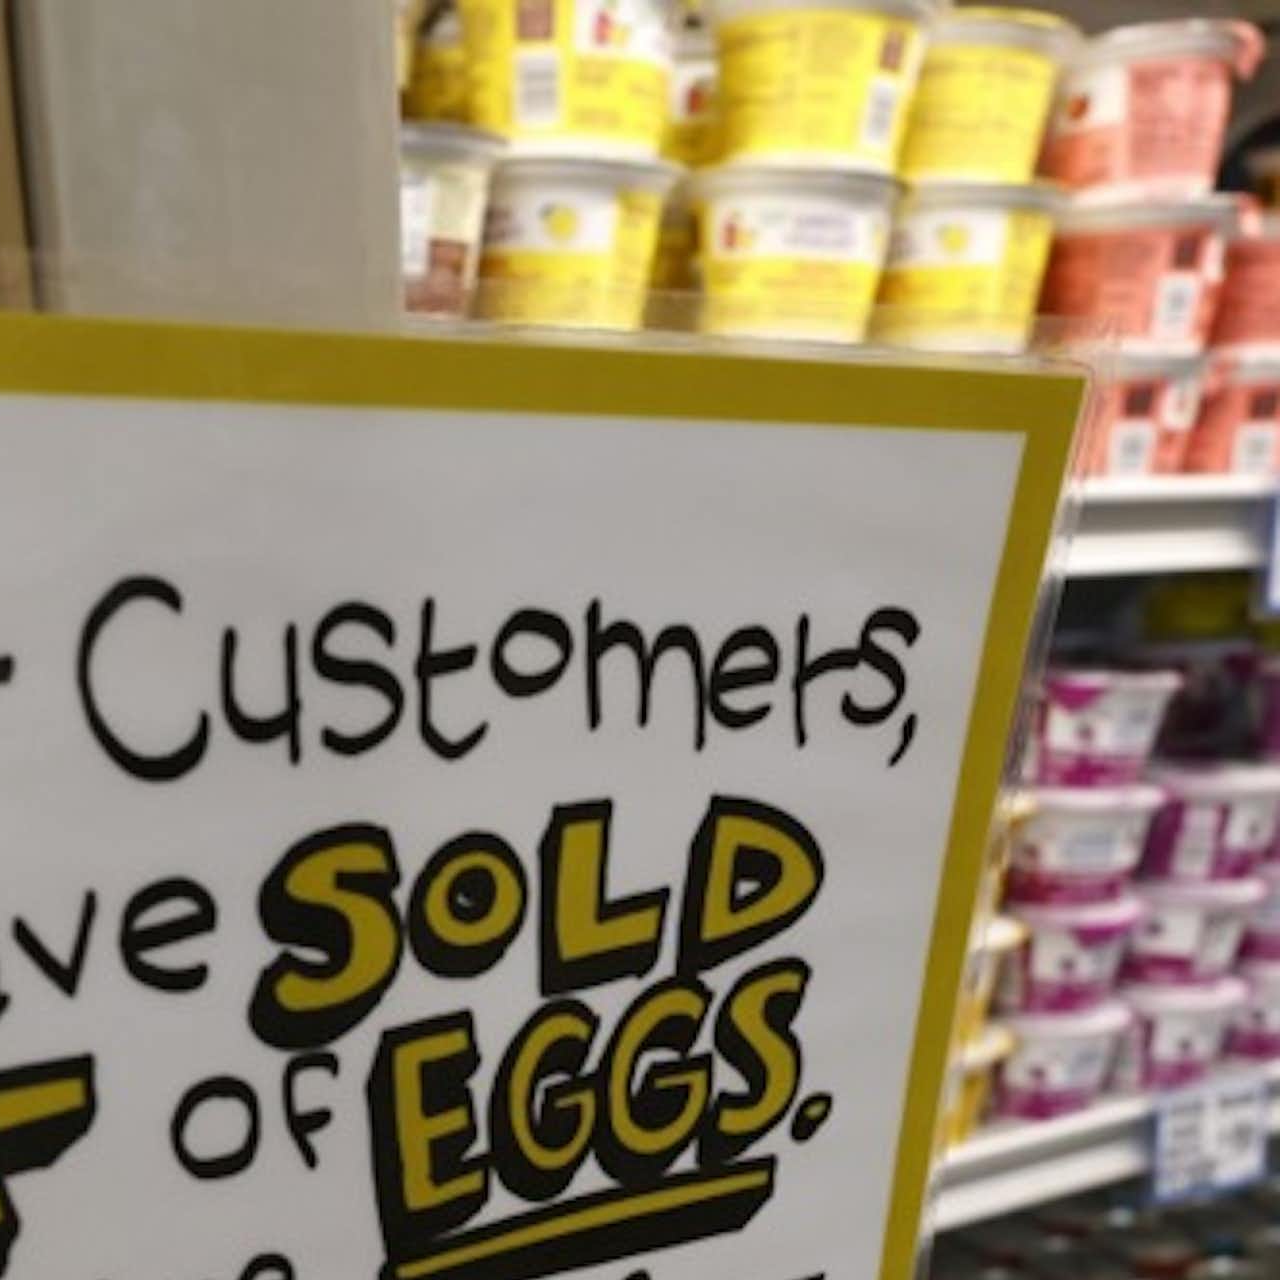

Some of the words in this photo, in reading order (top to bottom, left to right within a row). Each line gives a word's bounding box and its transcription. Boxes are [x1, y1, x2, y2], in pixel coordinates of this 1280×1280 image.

[75, 574, 922, 784] Customers,
[246, 793, 827, 1051] SOLD
[363, 955, 834, 1245] EGGS.
